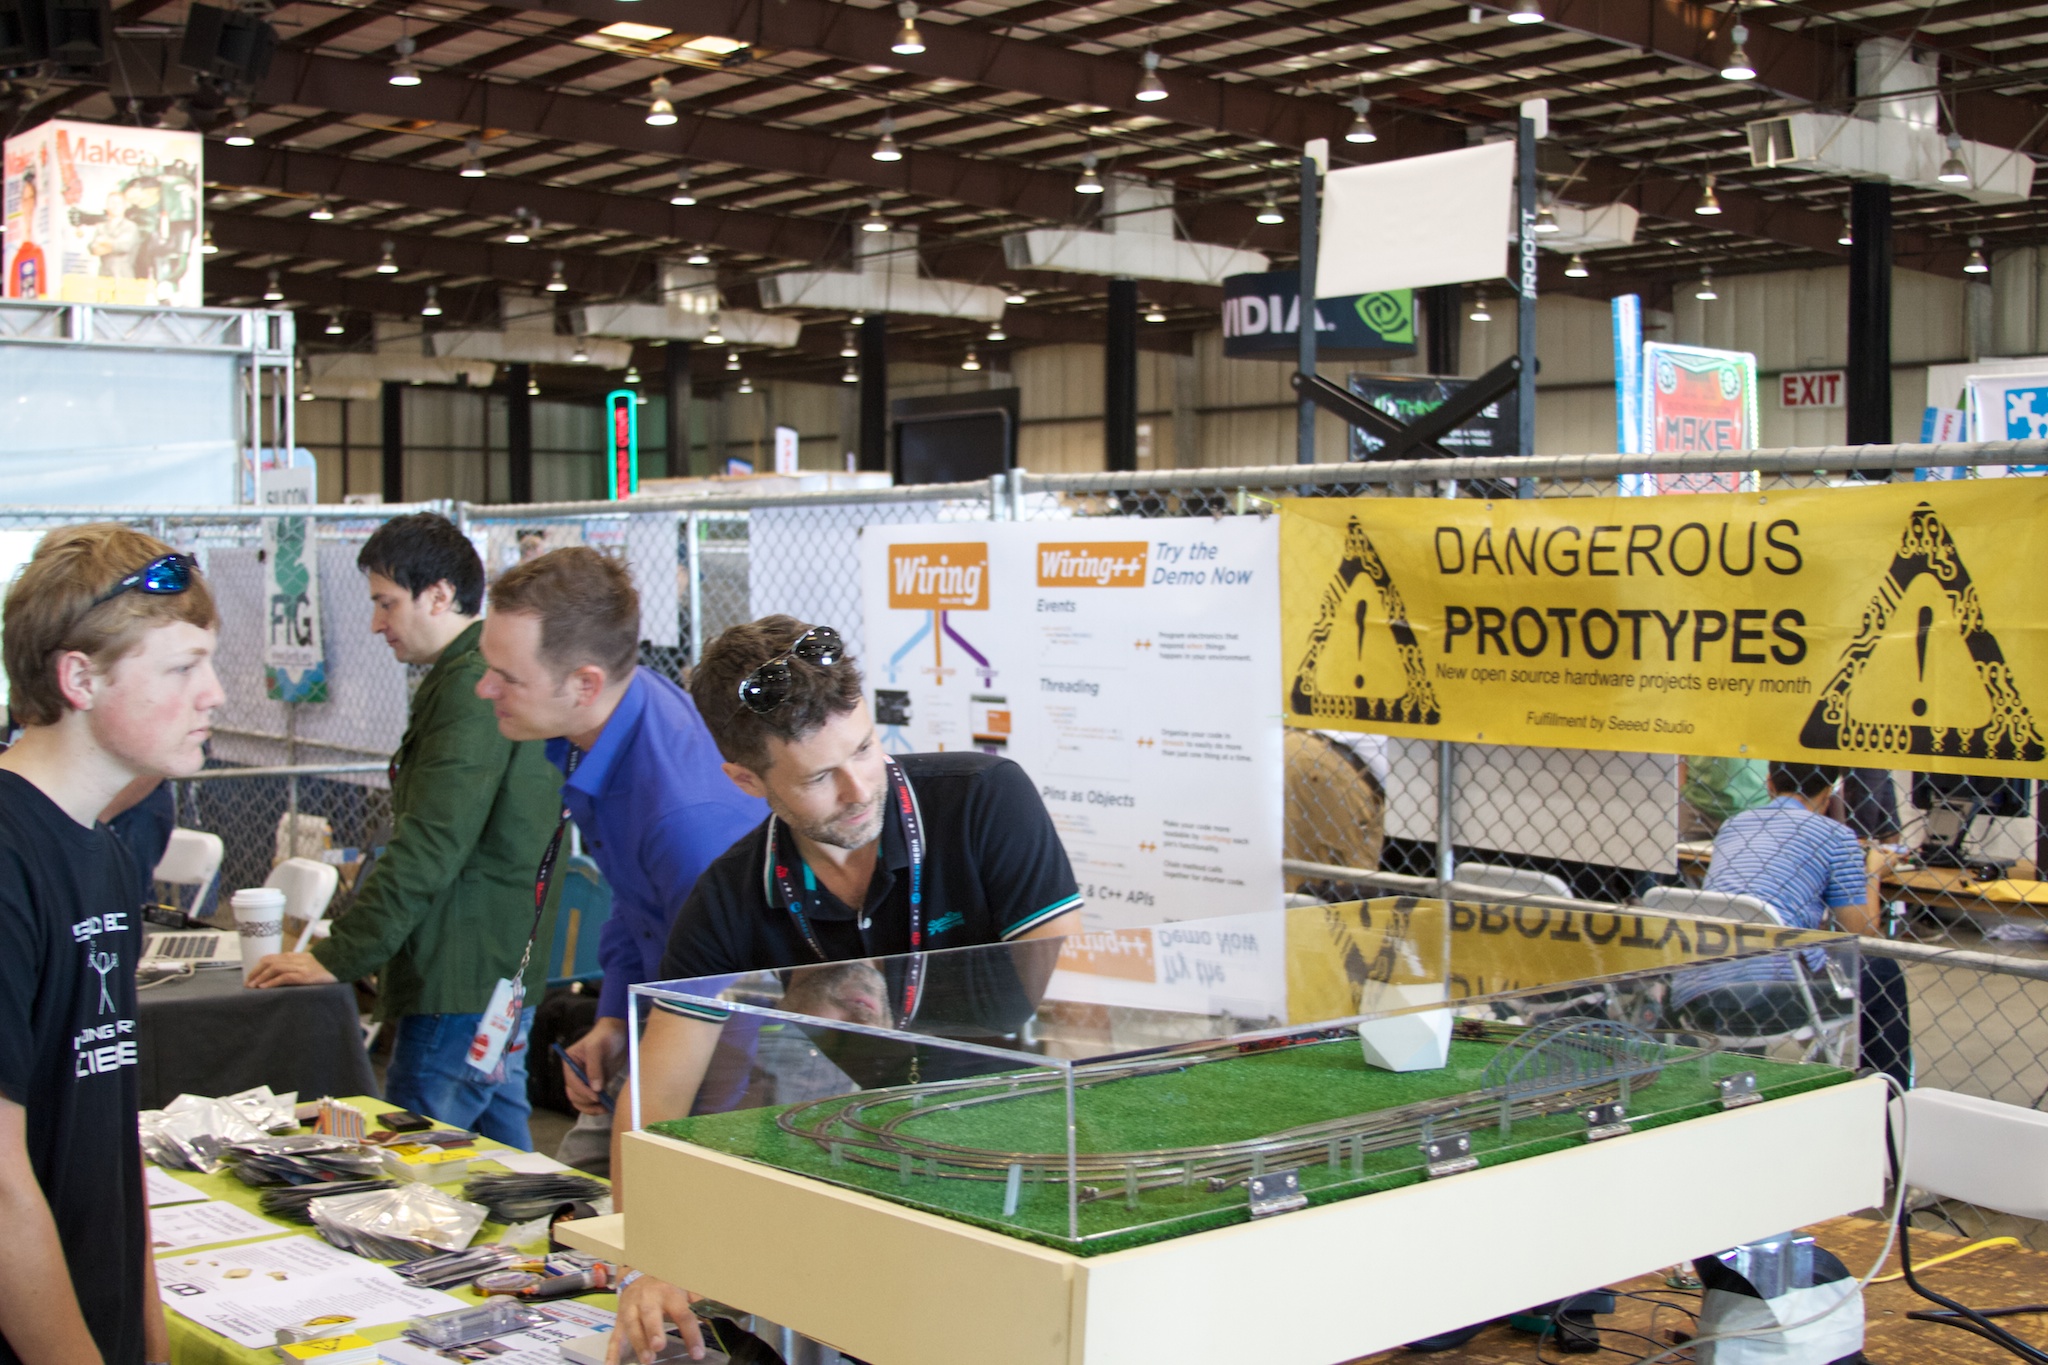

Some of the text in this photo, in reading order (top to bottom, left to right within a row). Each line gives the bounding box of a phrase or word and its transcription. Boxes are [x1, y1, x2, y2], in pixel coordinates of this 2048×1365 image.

[1782, 374, 1841, 406] EXIT
[1665, 416, 1734, 450] MAKE
[1156, 541, 1218, 564] Try the
[1435, 519, 1803, 577] DANGEROUS
[894, 554, 982, 606] Wiring
[1152, 566, 1253, 585] Demo Now
[1037, 598, 1076, 612] Events
[1444, 605, 1808, 666] PROTOTYPES
[1040, 678, 1099, 697] Threading
[1436, 662, 1812, 695] New open source hardware projects every month
[1526, 711, 1696, 735] Fulfillment by Seeed Studio
[1043, 785, 1136, 808] Pins as Objects
[1086, 884, 1155, 907] & C++ APIs
